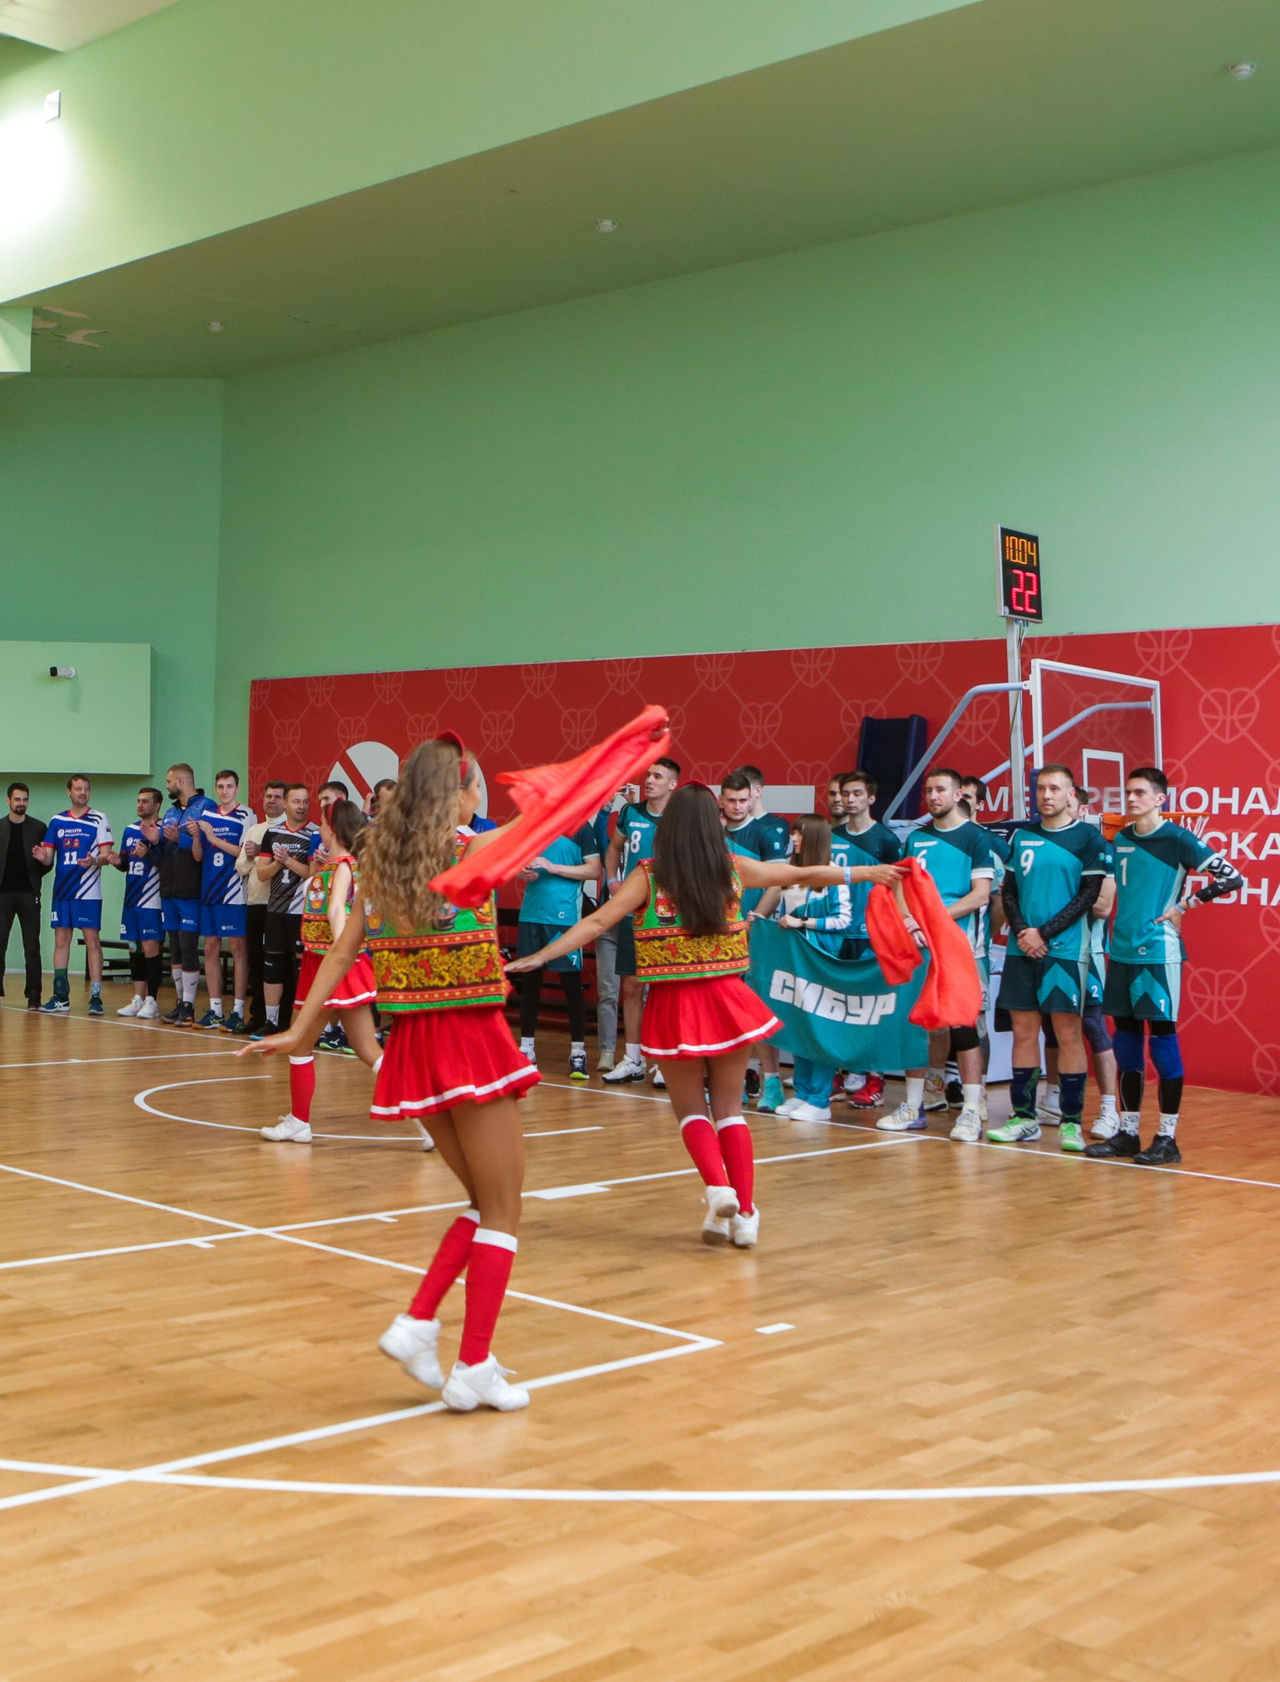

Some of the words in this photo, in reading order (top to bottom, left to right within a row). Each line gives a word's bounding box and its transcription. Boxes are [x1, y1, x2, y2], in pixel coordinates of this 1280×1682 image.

[1011, 569, 1038, 613] 22
[630, 830, 642, 854] 8
[63, 851, 78, 866] 11
[212, 852, 225, 867] 8
[1020, 848, 1035, 877] 9
[128, 861, 145, 876] 12
[1119, 857, 1128, 887] 1
[281, 869, 290, 884] 1
[769, 969, 897, 1026] СИБУР
[1090, 984, 1100, 998] 2
[1158, 998, 1166, 1013] 1
